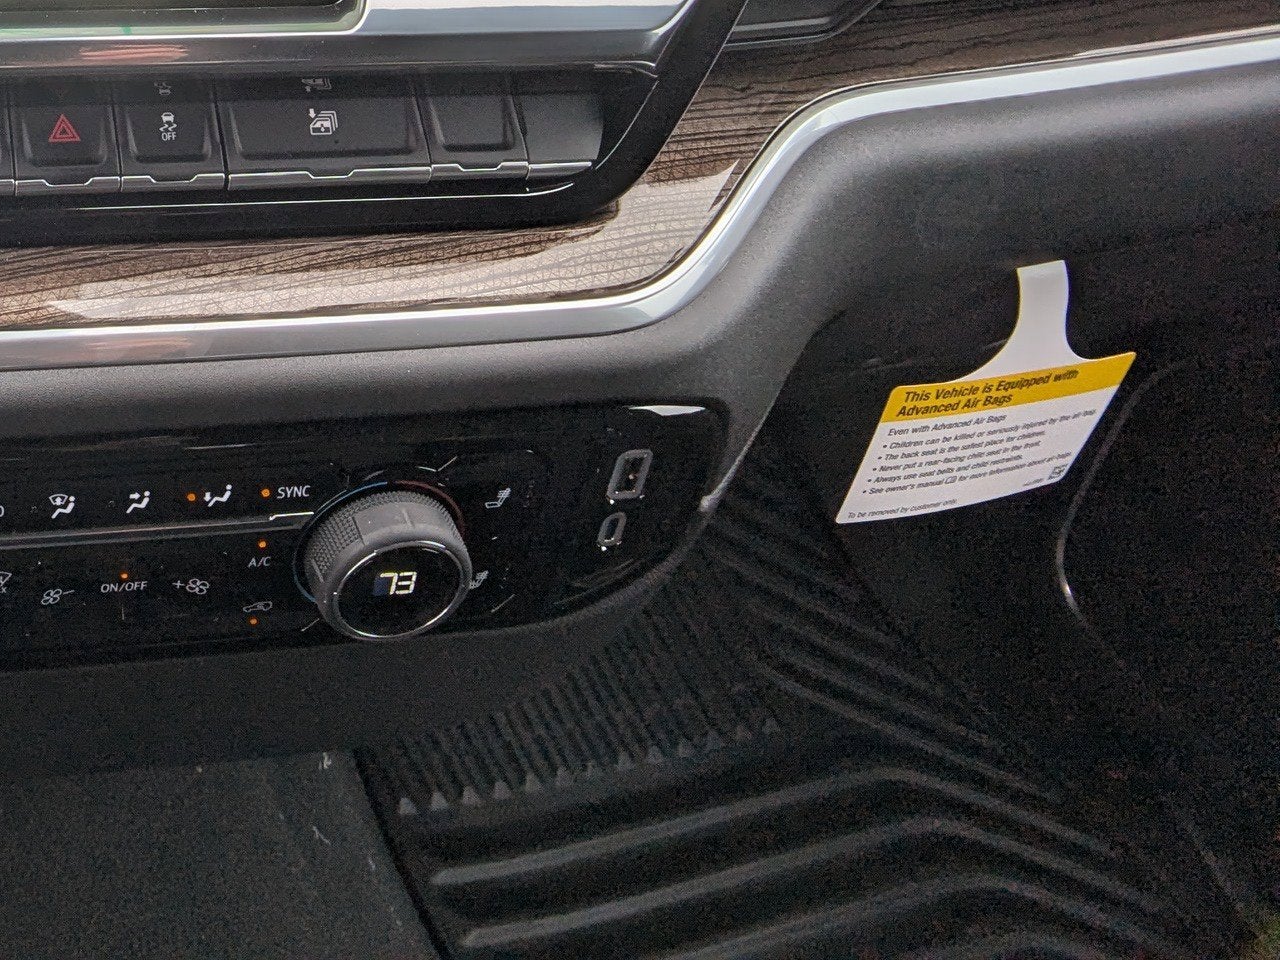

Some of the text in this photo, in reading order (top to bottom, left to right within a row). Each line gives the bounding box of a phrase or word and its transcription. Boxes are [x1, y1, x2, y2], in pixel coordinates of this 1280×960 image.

[161, 131, 177, 141] OFF
[904, 369, 1080, 403] This Vehicle is Equipped with
[896, 394, 1014, 417] Advanced Air Bags
[887, 415, 1007, 437] Even with Advanced Air Bags
[889, 440, 924, 449] Children
[942, 435, 953, 443] be
[953, 432, 976, 441] killed
[986, 425, 1020, 436] seriously
[1021, 420, 1048, 430] injured
[879, 464, 902, 472] Never
[902, 462, 917, 471] put
[924, 455, 967, 467] rear-facing
[966, 451, 986, 460] child
[985, 448, 1002, 456] seat
[884, 453, 899, 461] The
[900, 451, 920, 459] back
[921, 448, 938, 457] seat
[947, 445, 960, 453] the
[960, 441, 985, 451] safest
[984, 439, 1005, 448] place
[868, 487, 885, 495] See
[885, 483, 915, 493] owner's
[916, 480, 944, 489] manual
[968, 471, 988, 480] more
[989, 463, 1027, 476] information
[873, 476, 902, 484] Always
[919, 470, 936, 478] seat
[936, 467, 956, 475] belts
[955, 464, 971, 472] and
[970, 461, 989, 470] child
[277, 485, 311, 499] SYNC
[857, 510, 867, 518] be
[867, 506, 900, 517] removed
[910, 500, 943, 512] customer
[248, 556, 271, 568] A/C
[101, 581, 148, 593] ON/OFF
[379, 571, 417, 595] 73
